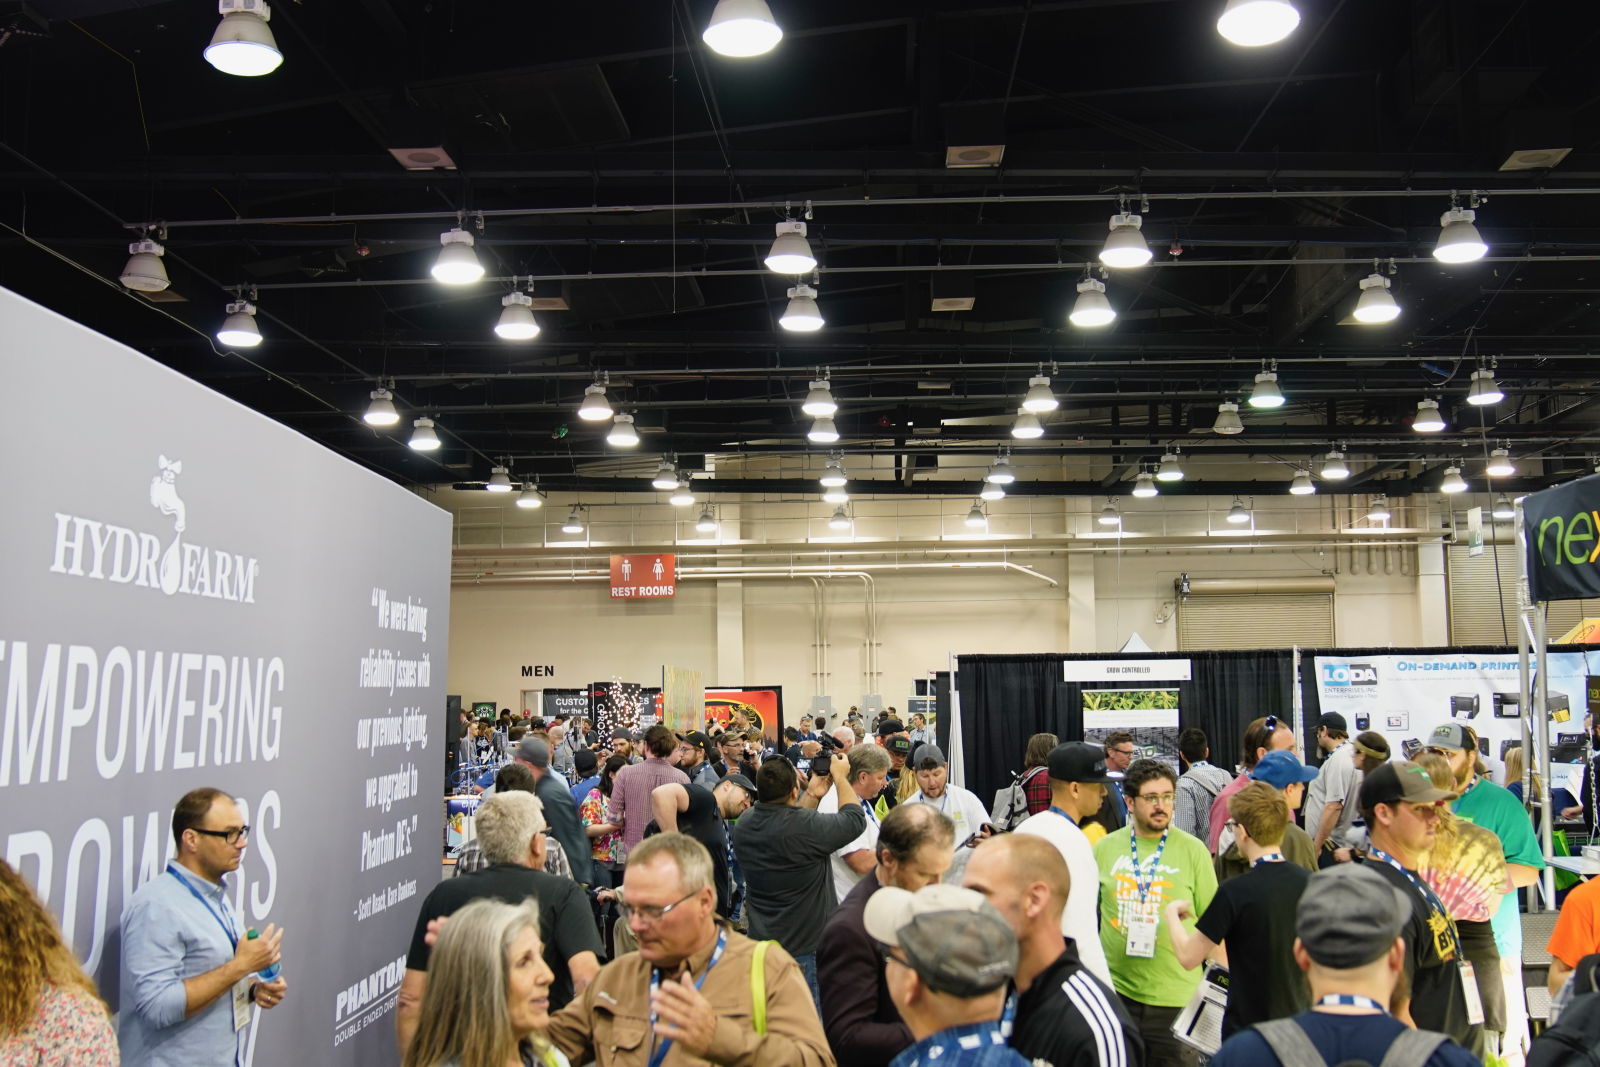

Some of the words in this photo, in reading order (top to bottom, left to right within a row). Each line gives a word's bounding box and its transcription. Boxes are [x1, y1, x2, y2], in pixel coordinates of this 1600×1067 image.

[611, 586, 637, 597] REST
[639, 585, 674, 596] ROOMS
[390, 600, 407, 631] were
[407, 595, 428, 642] having
[360, 648, 397, 696] reliability
[396, 650, 417, 688] issues
[417, 652, 431, 688] with
[521, 665, 554, 677] MEN
[0, 640, 285, 787] MPOWERING
[357, 718, 372, 749] our
[370, 707, 402, 757] previous
[366, 777, 378, 808] we
[377, 762, 411, 814] upgraded
[410, 764, 419, 797] to
[361, 828, 396, 872] Phantom
[358, 896, 372, 921] Scott
[387, 886, 398, 907] Rare
[397, 879, 417, 902] Dankness
[336, 954, 407, 1022] PHANTOM
[334, 1019, 362, 1047] DOUBLE
[363, 1006, 385, 1028] ENDED
[383, 994, 400, 1014] DIGIT
